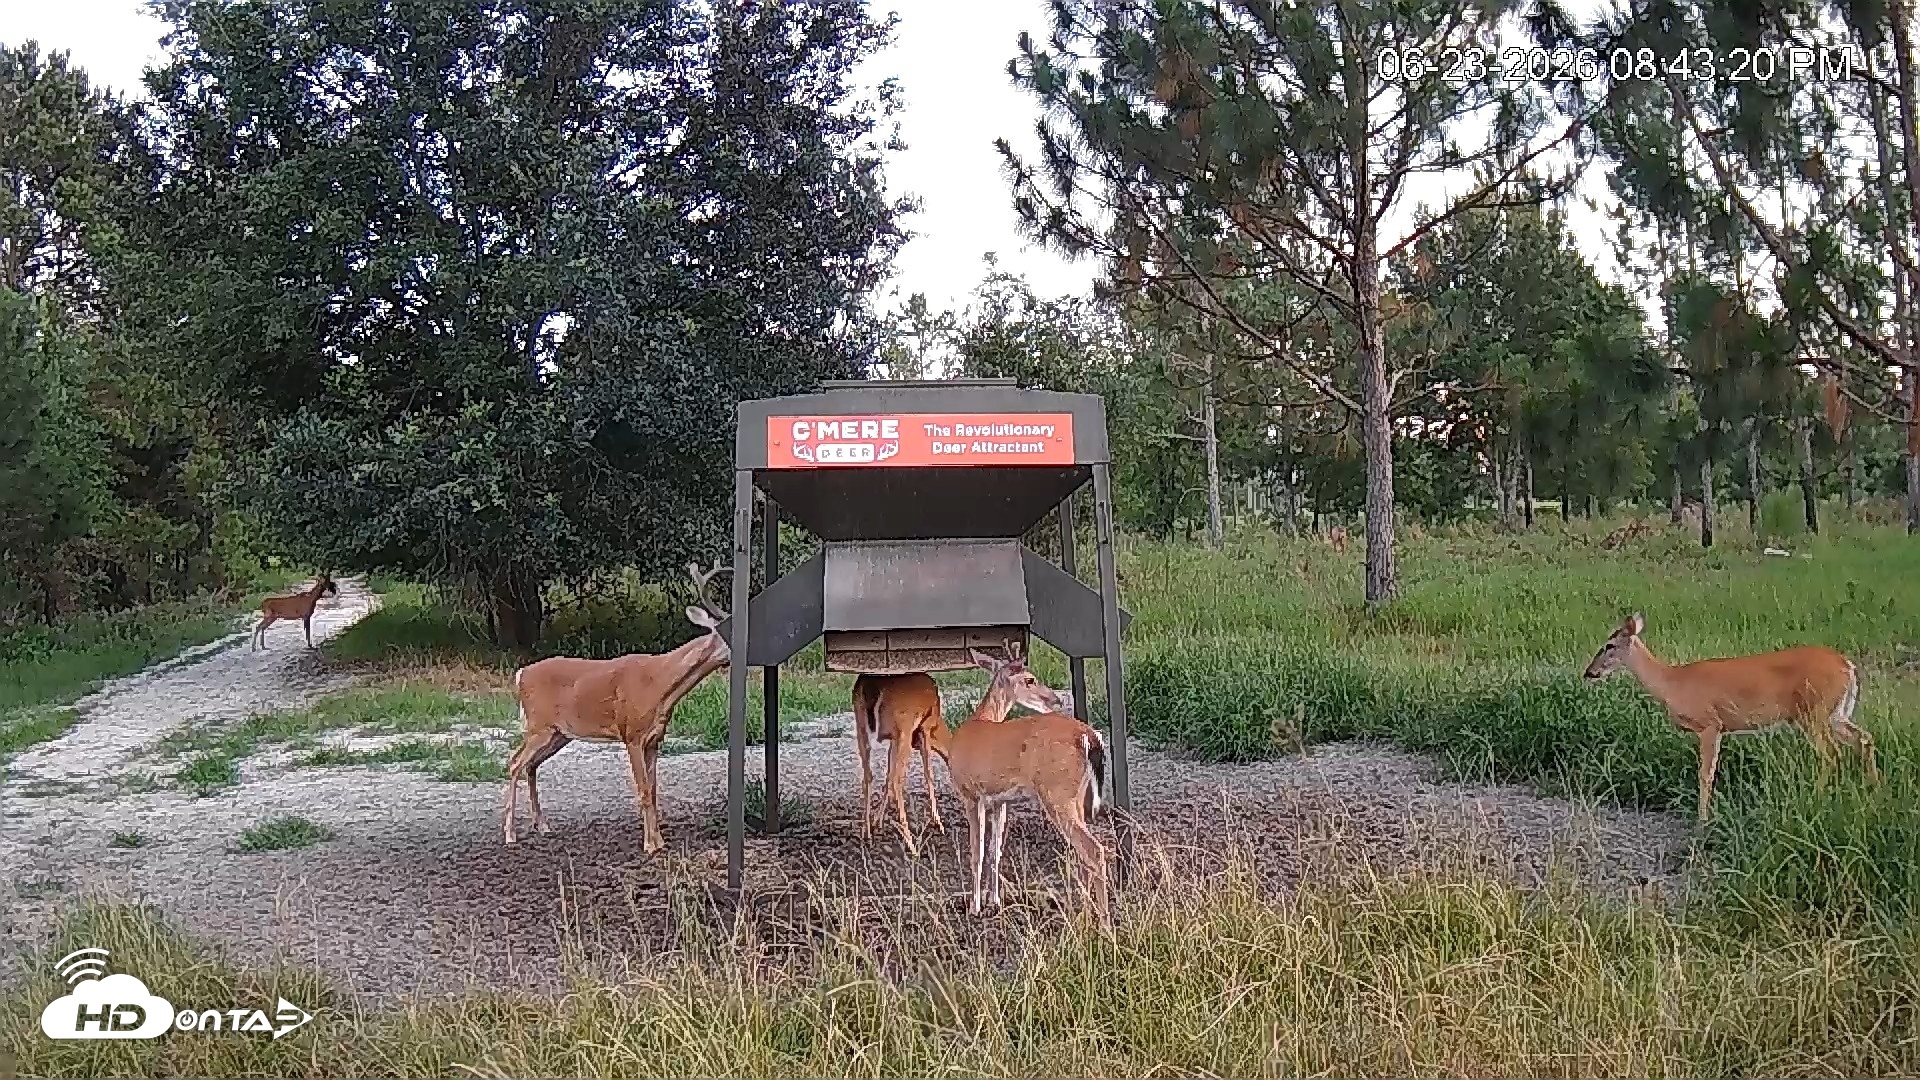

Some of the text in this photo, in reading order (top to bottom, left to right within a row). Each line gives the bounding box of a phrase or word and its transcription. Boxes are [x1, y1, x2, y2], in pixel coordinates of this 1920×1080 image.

[792, 419, 899, 440] C'MERE
[924, 423, 1055, 438] The Revolutionary
[821, 448, 871, 459] DEER
[932, 441, 1045, 454] Deer Attractant
